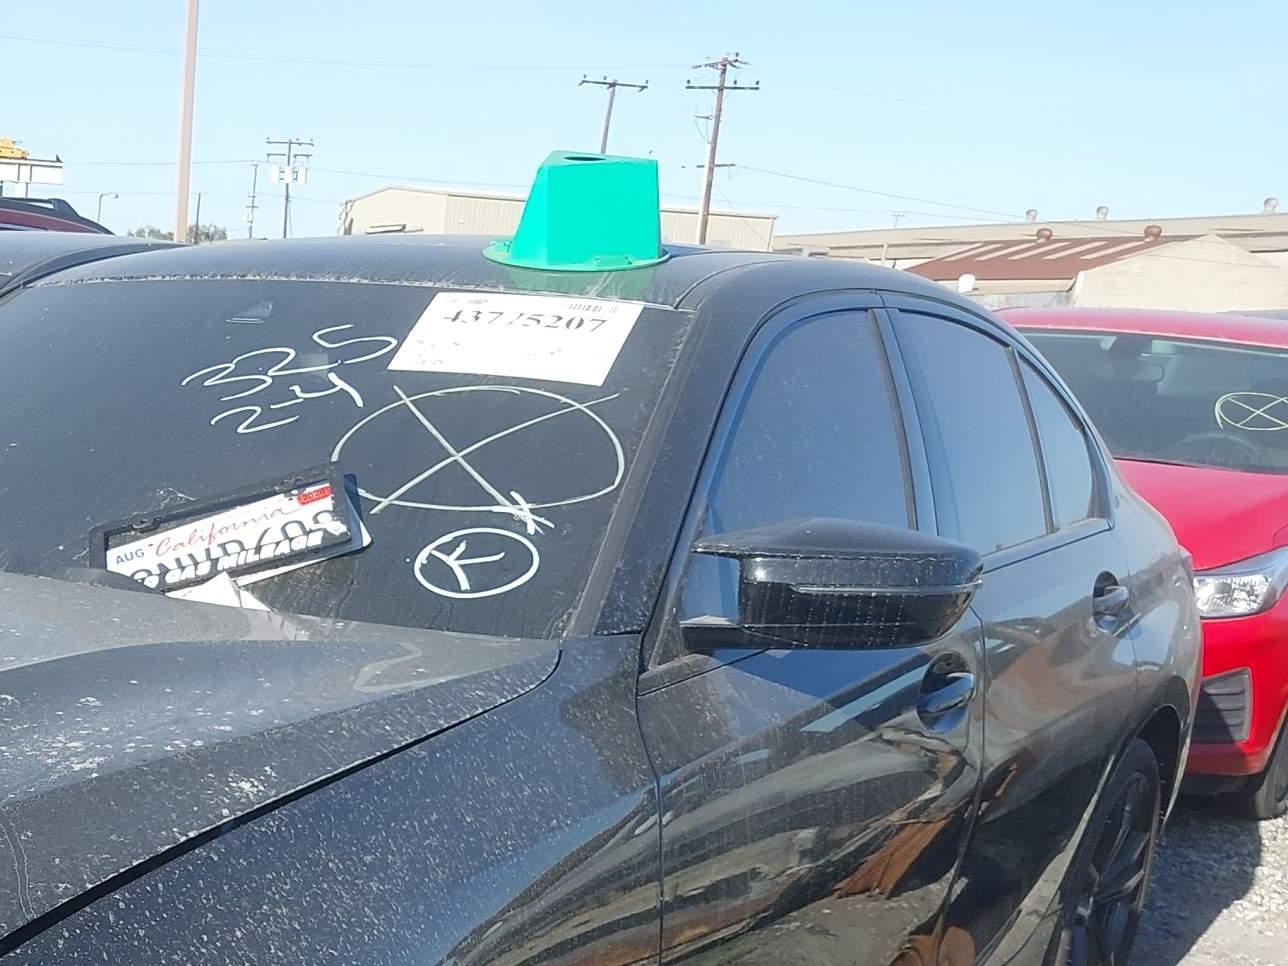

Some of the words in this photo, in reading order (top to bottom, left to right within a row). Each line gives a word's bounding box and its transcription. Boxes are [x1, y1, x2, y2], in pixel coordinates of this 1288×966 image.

[181, 323, 399, 402] 325
[154, 504, 300, 557] California
[115, 549, 145, 566] AUG
